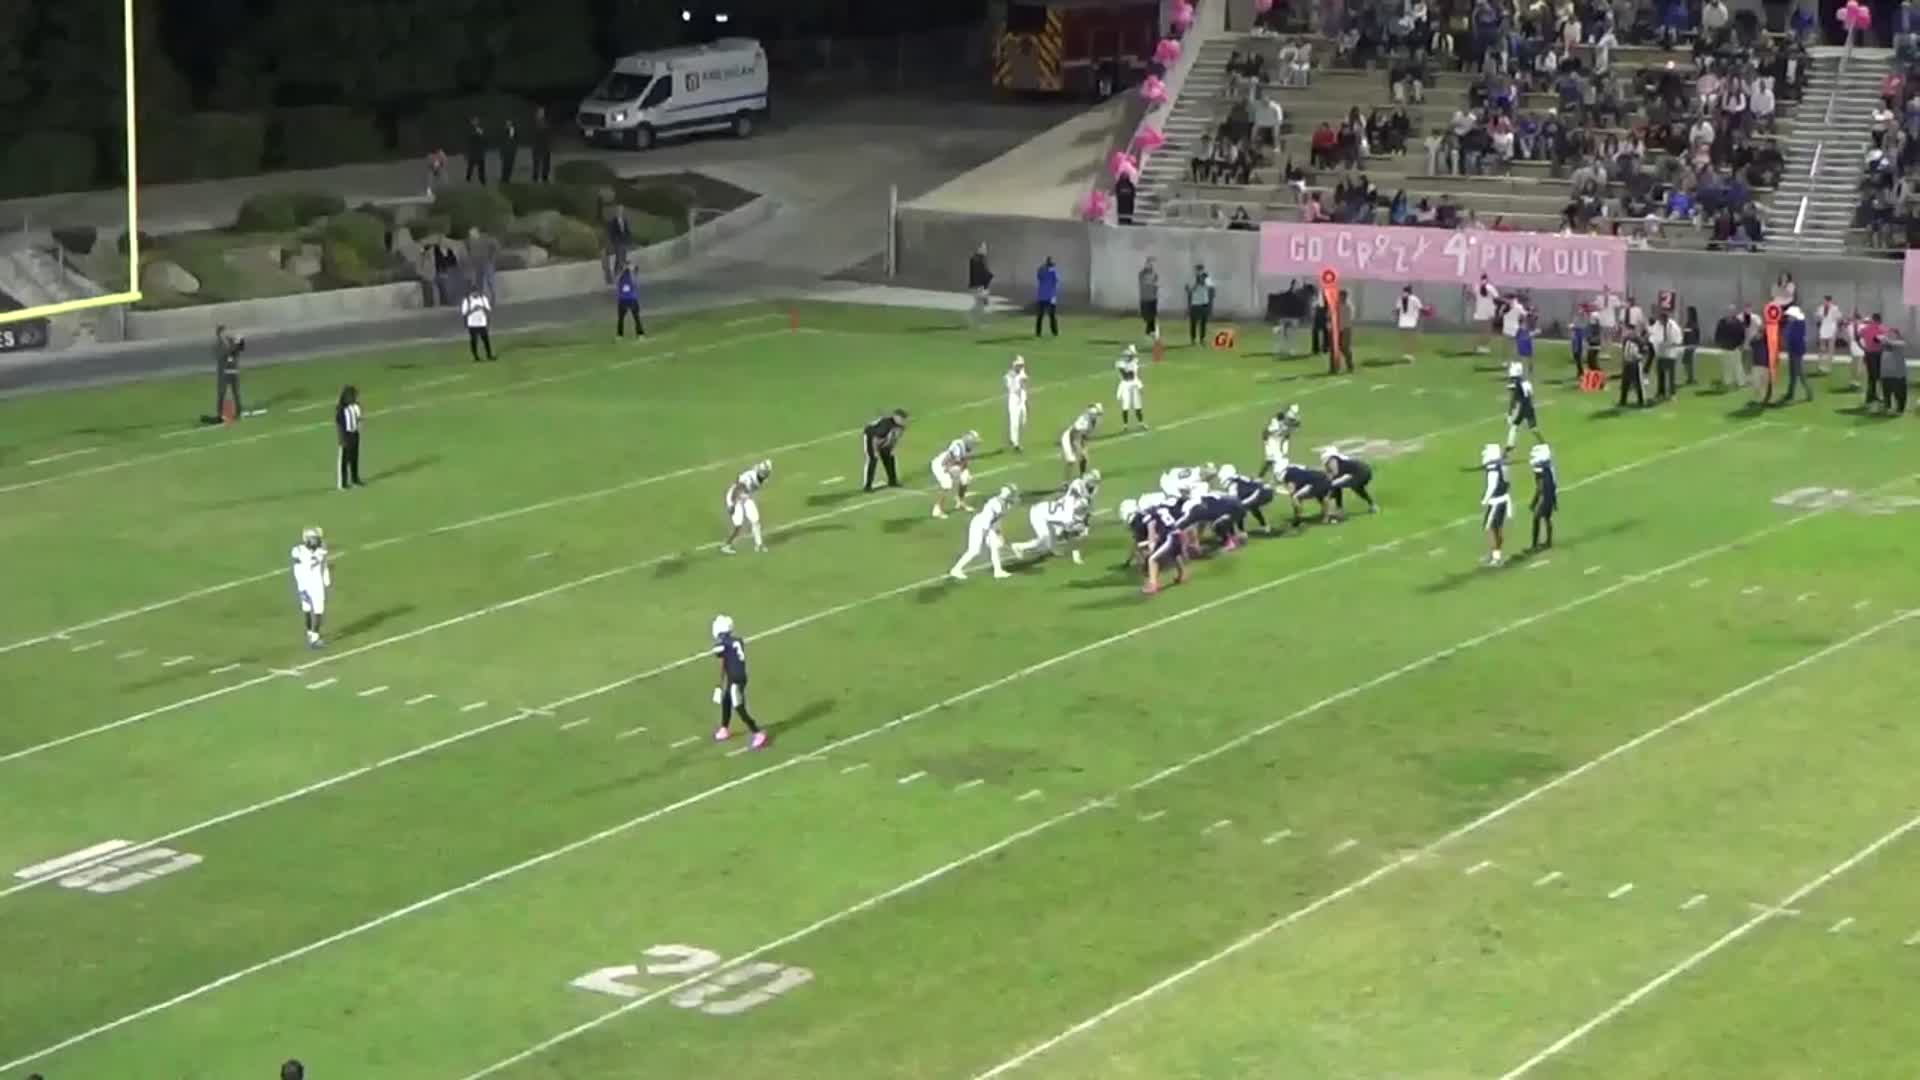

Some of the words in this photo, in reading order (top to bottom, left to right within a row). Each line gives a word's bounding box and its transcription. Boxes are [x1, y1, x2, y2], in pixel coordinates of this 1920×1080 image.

[1480, 244, 1542, 273] PINK
[1553, 249, 1610, 277] OUT
[568, 943, 815, 1015] 20
